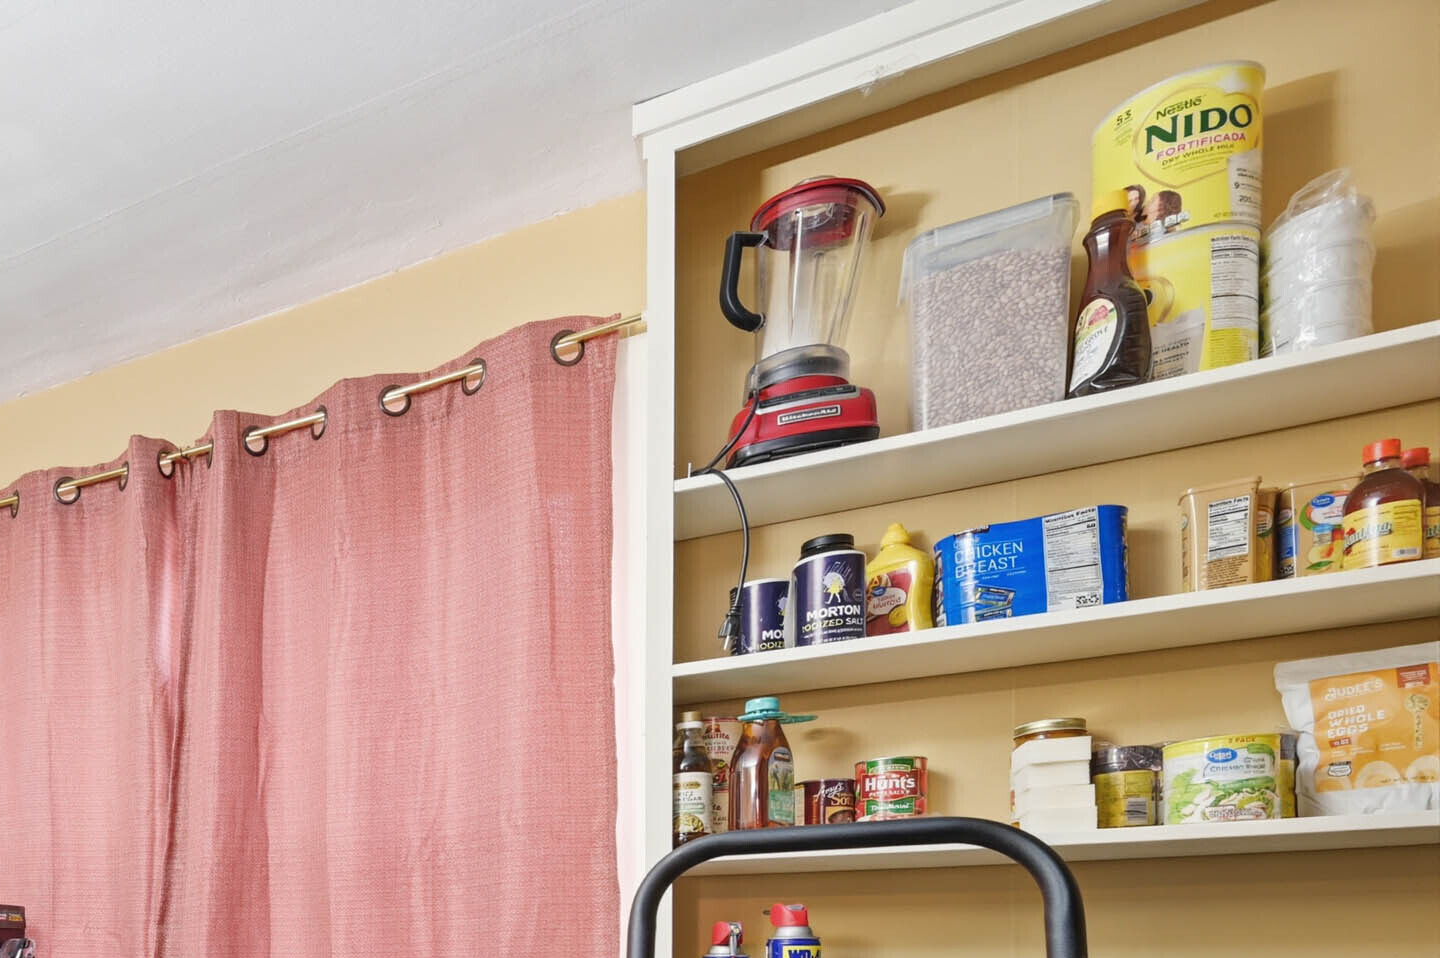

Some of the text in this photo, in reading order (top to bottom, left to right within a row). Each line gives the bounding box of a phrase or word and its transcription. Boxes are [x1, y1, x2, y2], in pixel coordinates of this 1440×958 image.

[1145, 104, 1253, 155] NIDO
[1156, 132, 1247, 160] FORTIFICADA
[1183, 145, 1214, 159] WHOLE
[954, 541, 1024, 565] CHICKEN
[955, 556, 1019, 579] BREAST
[806, 604, 861, 622] MORTON
[1328, 704, 1365, 720] DRIED
[1329, 709, 1386, 728] WHOLE
[1327, 723, 1369, 739] EGGS
[864, 774, 916, 792] Hunt's
